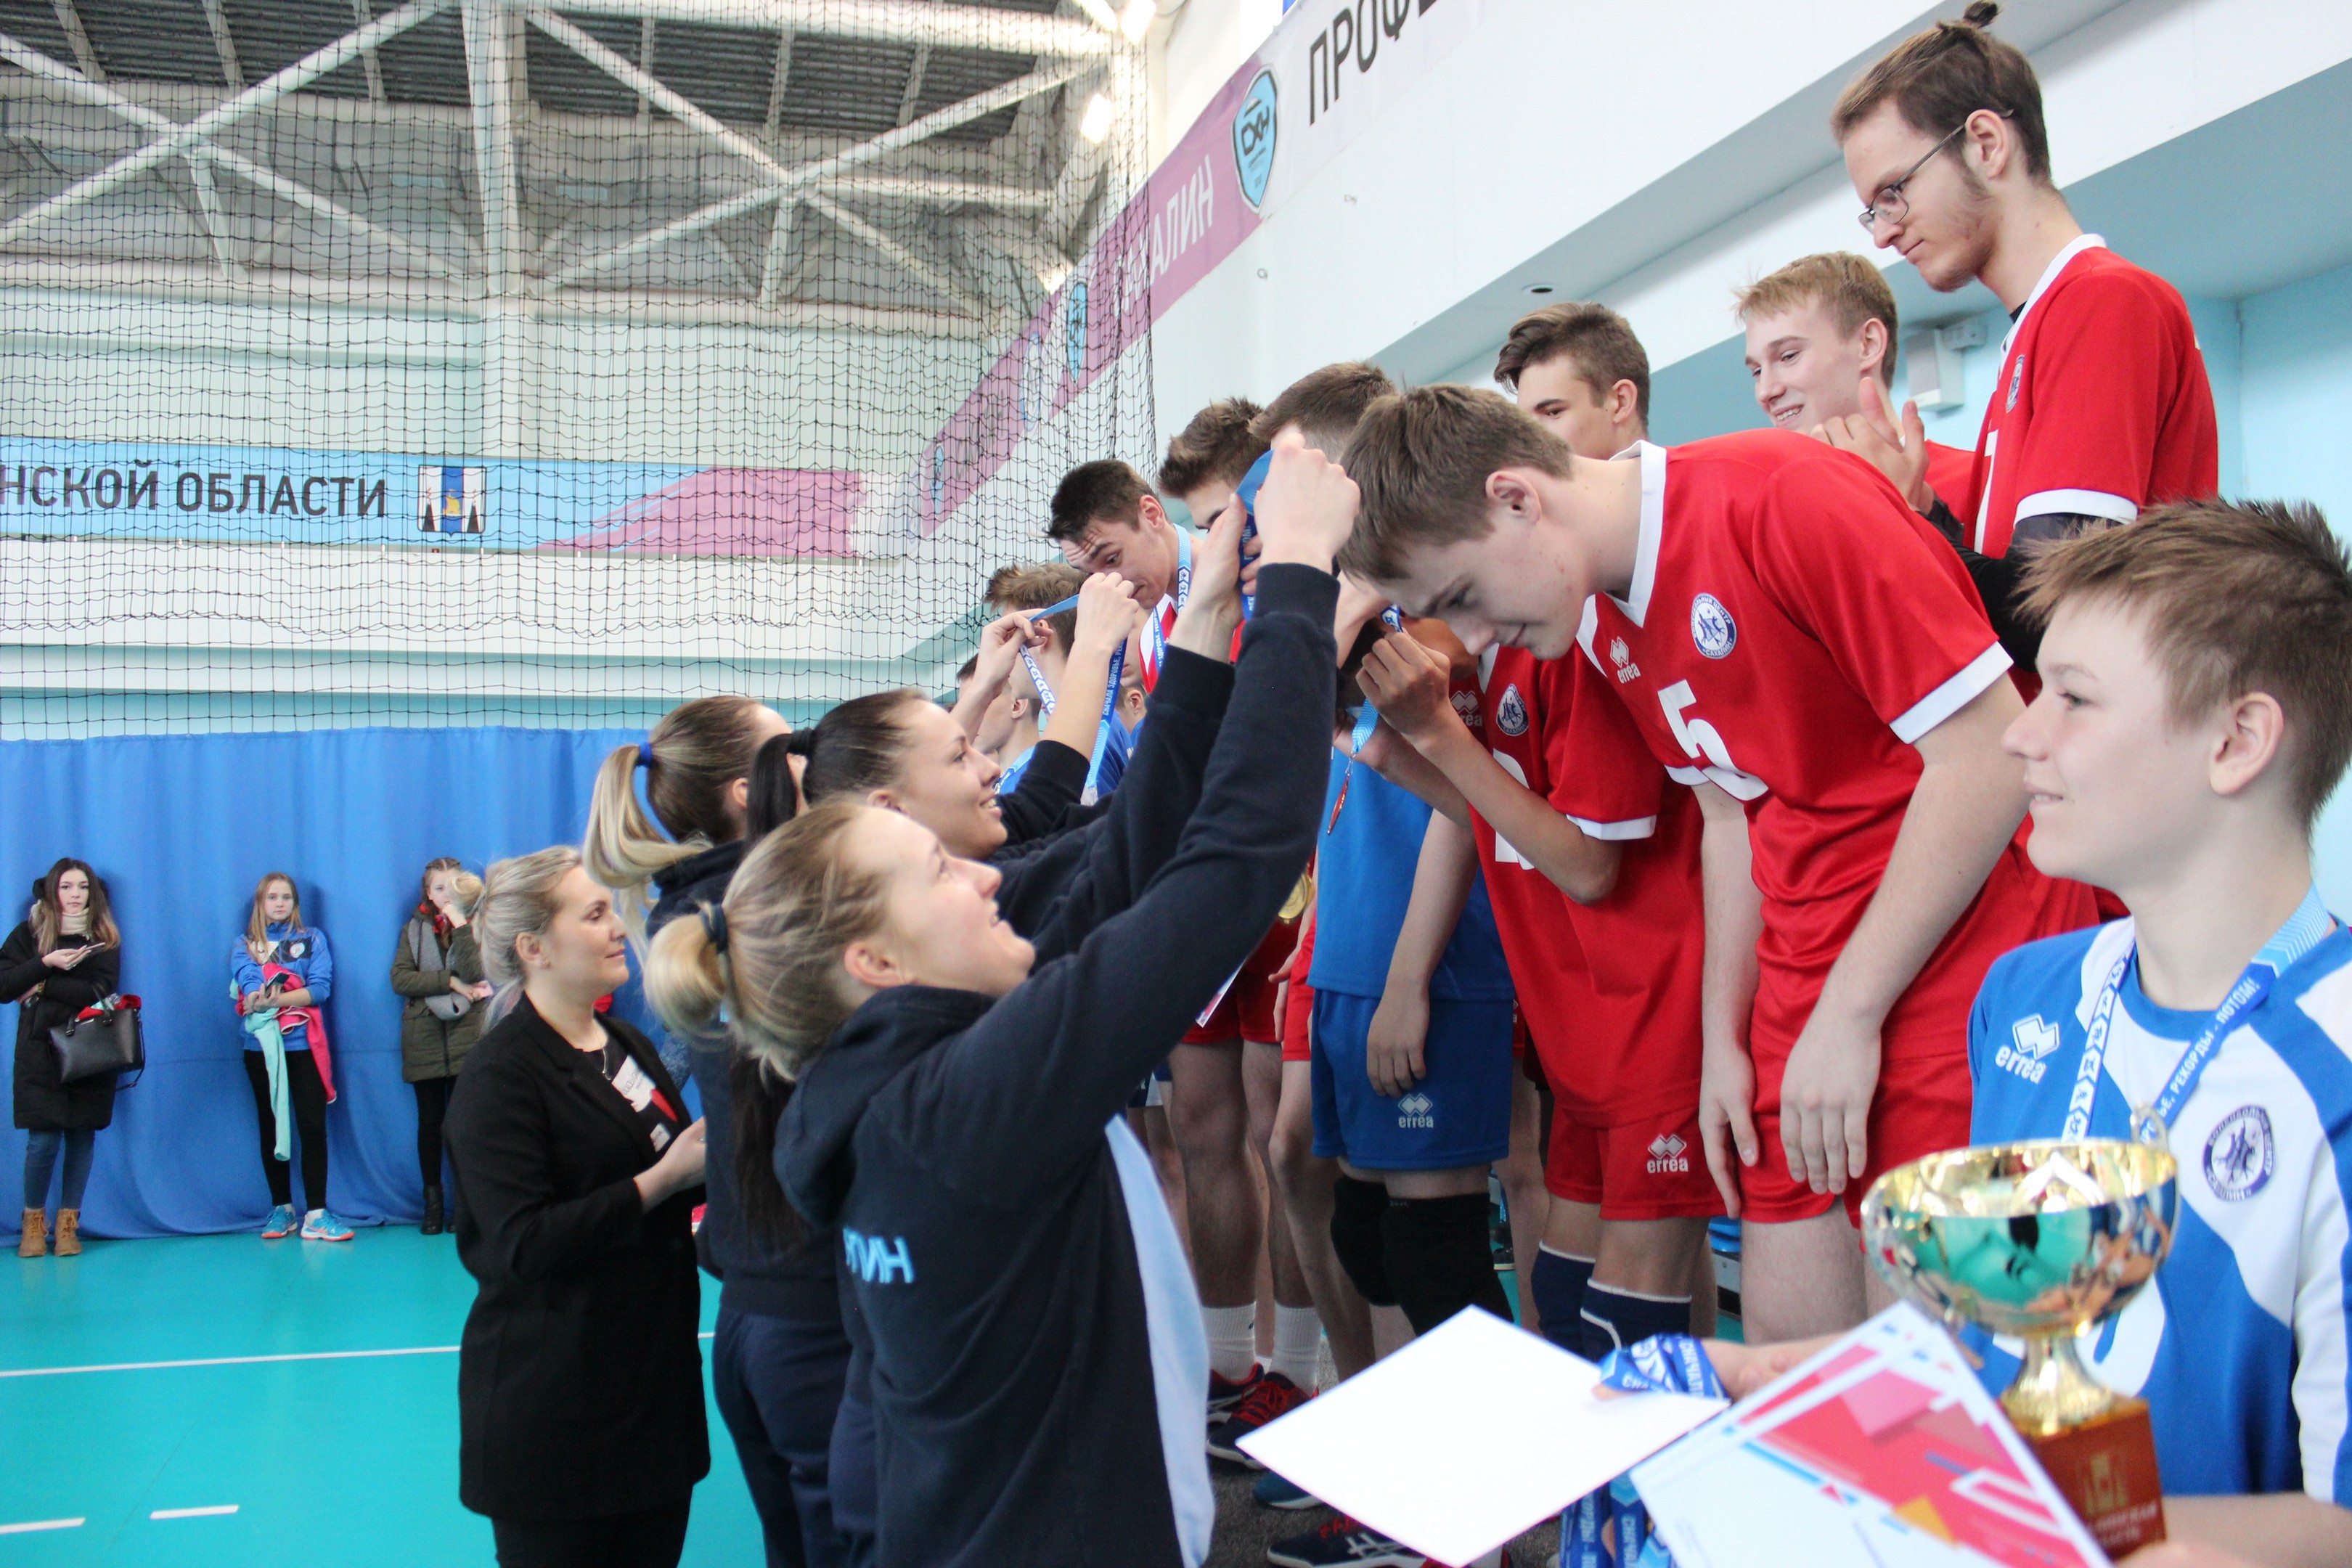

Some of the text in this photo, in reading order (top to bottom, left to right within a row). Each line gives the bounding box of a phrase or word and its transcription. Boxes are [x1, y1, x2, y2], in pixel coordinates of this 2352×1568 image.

[1310, 0, 1438, 126] ПРОФ
[0, 459, 385, 518] НСКОЙ ОБЛАСТИ
[1102, 689, 1115, 716] СНАЧАЛА
[1657, 678, 1769, 801] 5
[2169, 1029, 2215, 1095] РЕКОРДЫ
[2216, 976, 2261, 1024] ПОТОМ!
[1646, 1157, 1689, 1174] errea
